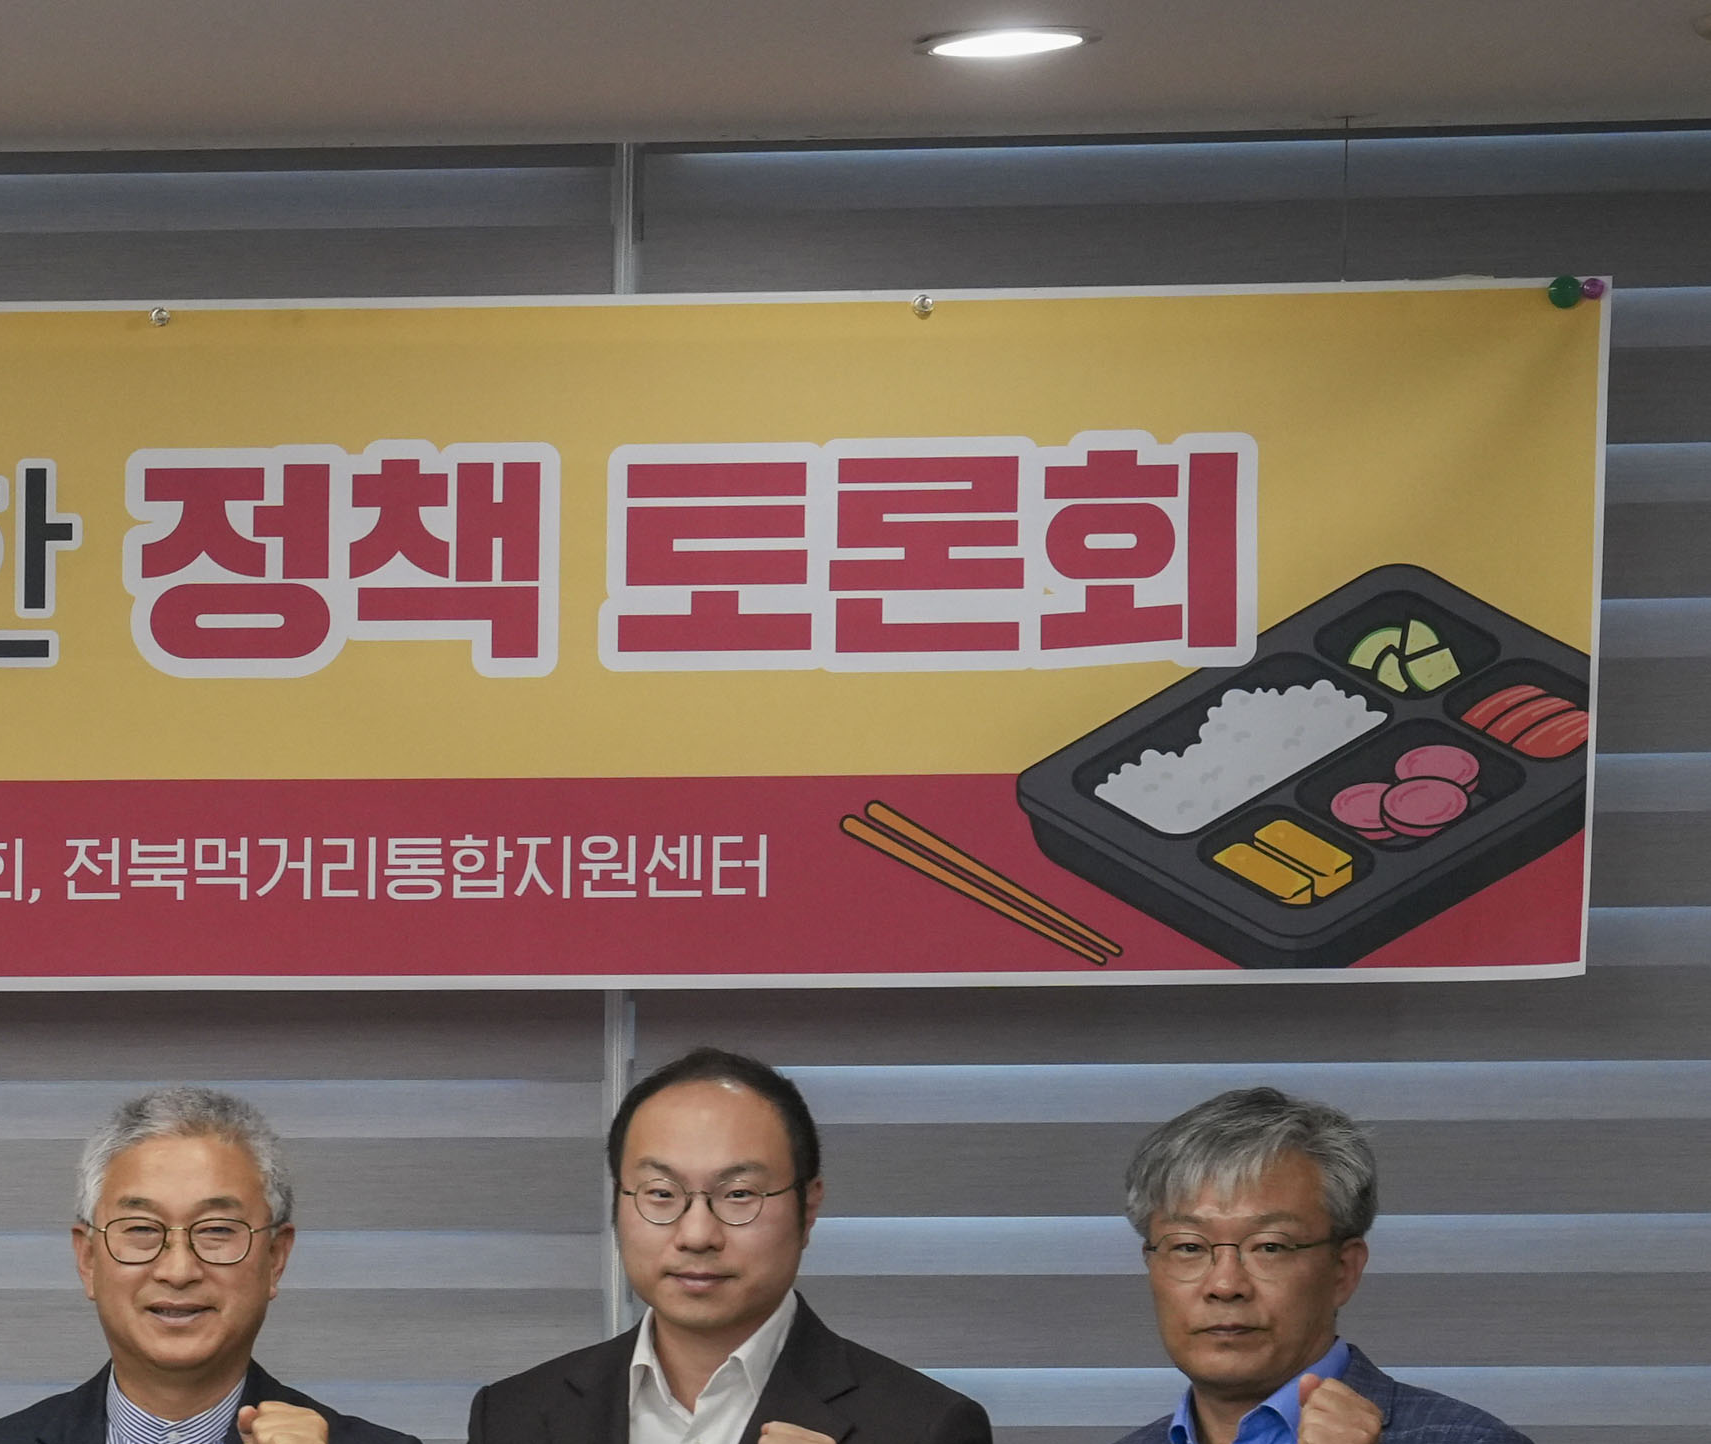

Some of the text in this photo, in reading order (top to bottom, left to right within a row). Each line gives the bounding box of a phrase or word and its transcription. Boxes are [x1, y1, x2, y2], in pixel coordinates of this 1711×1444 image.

[141, 458, 541, 659] 정책
[618, 450, 1238, 653] 토론회
[62, 833, 769, 902] 전북먹거리통합지원센터
